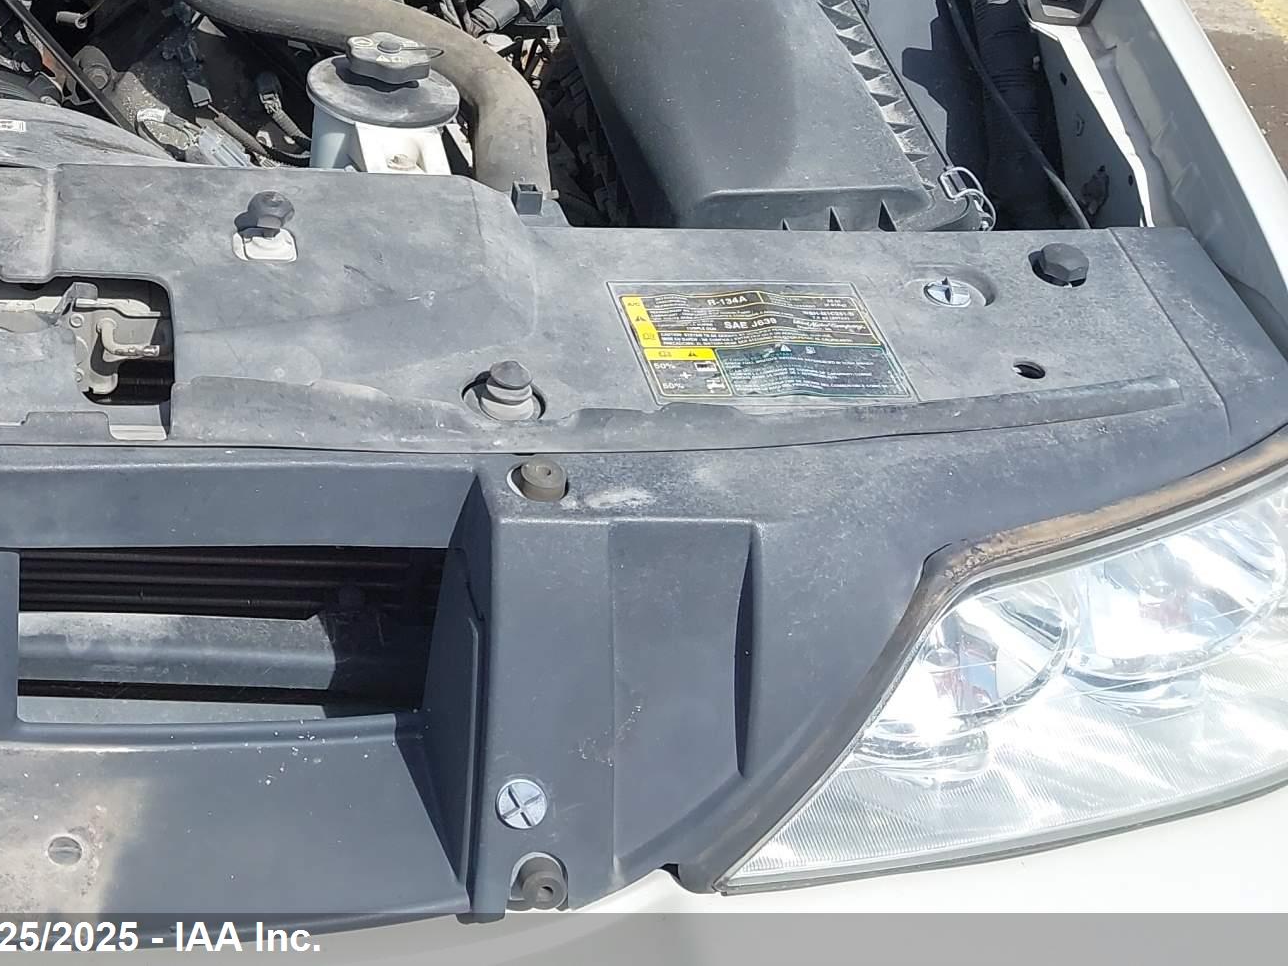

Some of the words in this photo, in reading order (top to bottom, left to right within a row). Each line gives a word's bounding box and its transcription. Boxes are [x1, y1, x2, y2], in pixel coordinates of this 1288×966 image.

[707, 295, 748, 306] R-134A
[724, 320, 749, 330] SAE
[654, 362, 676, 370] 50%
[662, 382, 685, 390] 50%
